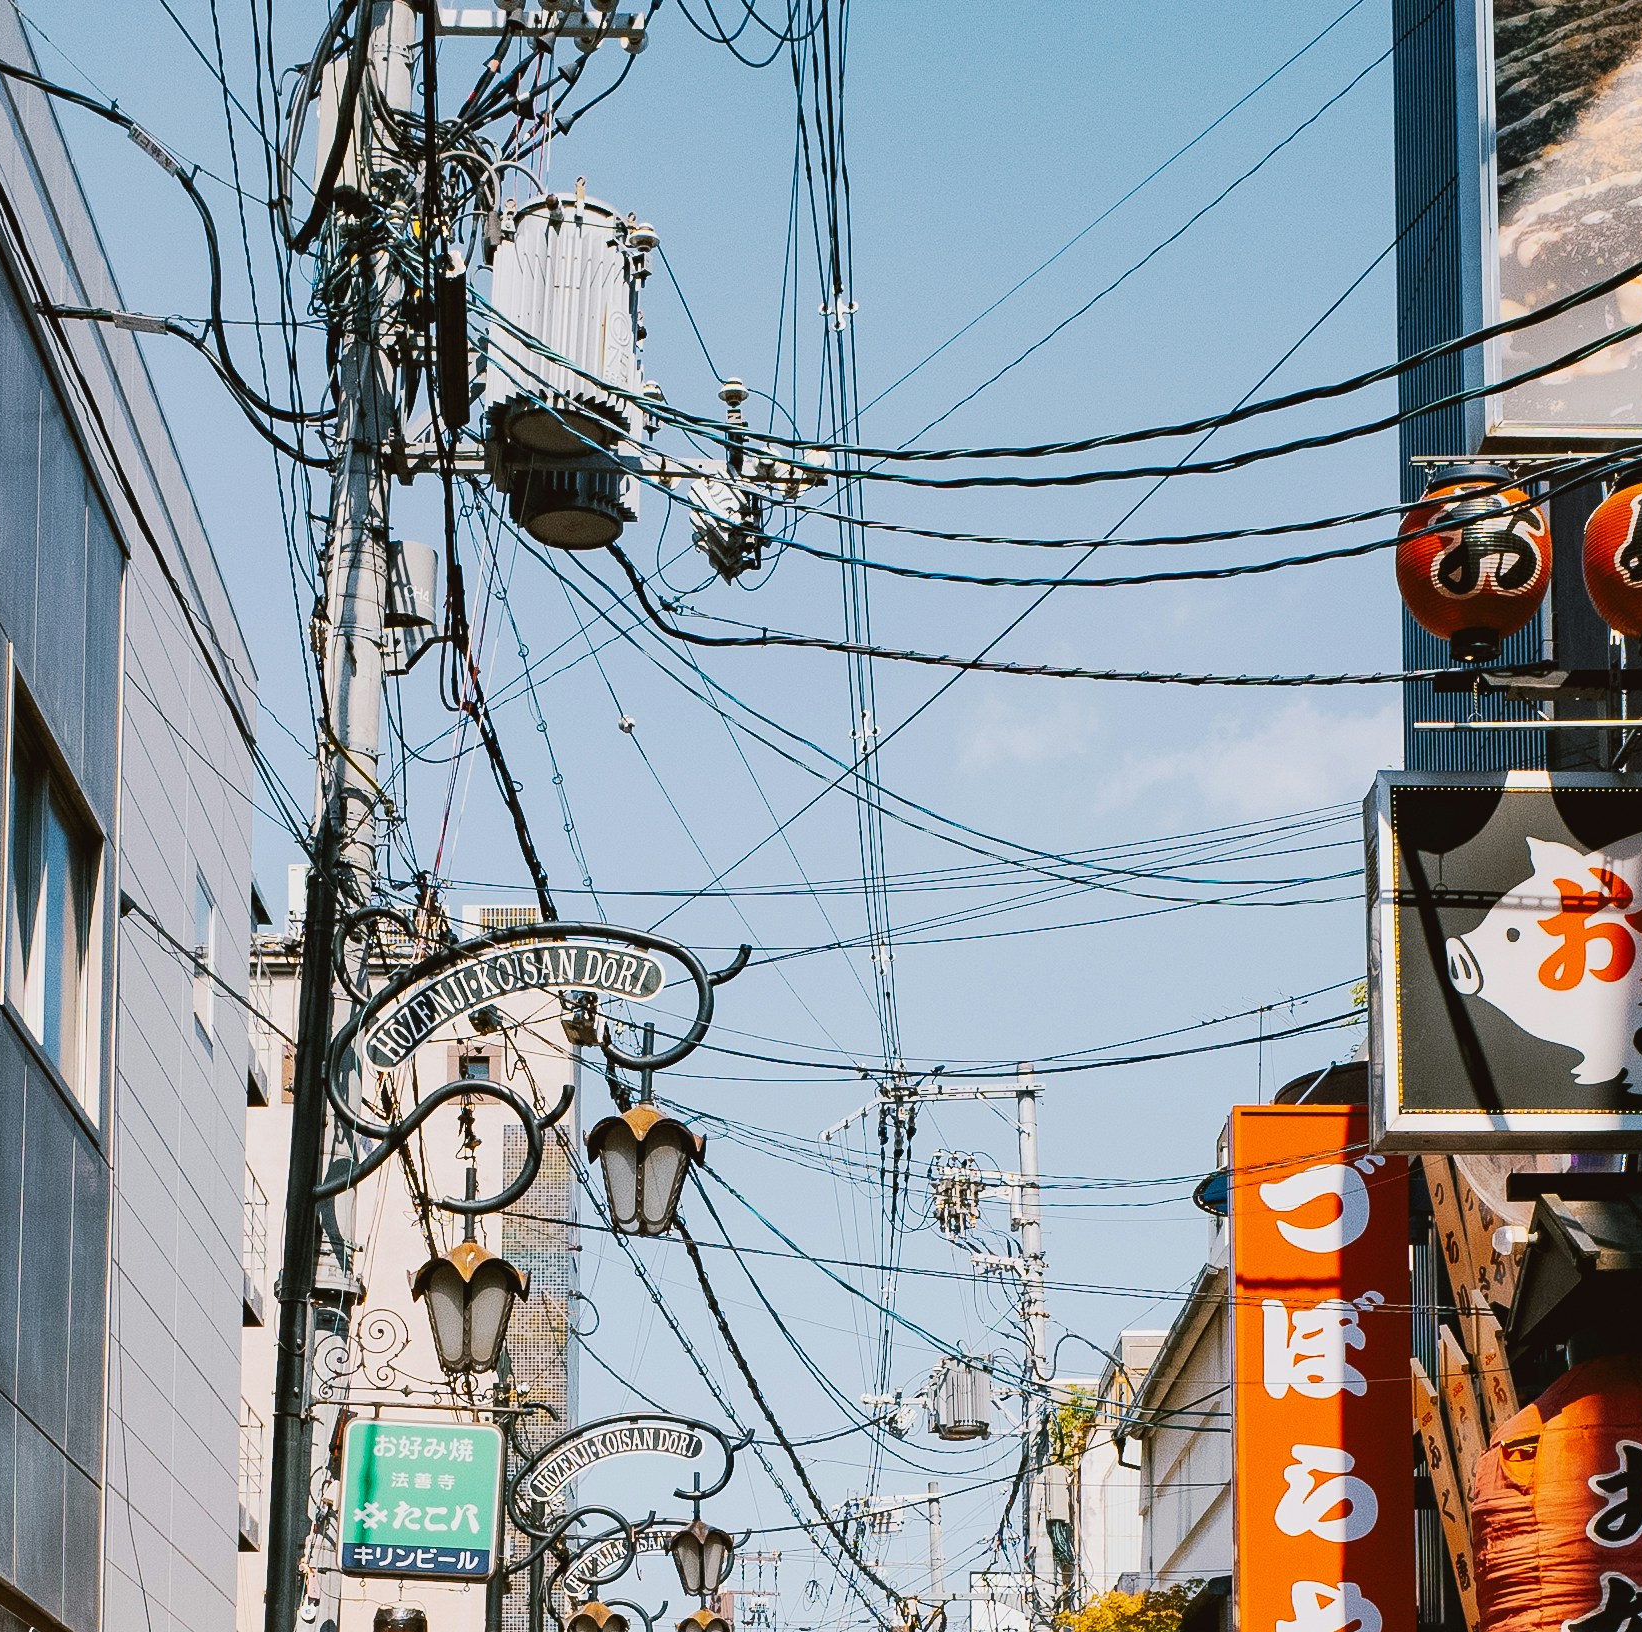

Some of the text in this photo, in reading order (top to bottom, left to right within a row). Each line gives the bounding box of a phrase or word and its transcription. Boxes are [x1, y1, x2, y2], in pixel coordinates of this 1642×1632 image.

[373, 1435, 474, 1461] お好み焼
[391, 1471, 455, 1491] 法善寺
[354, 1545, 479, 1571] キリンビール
